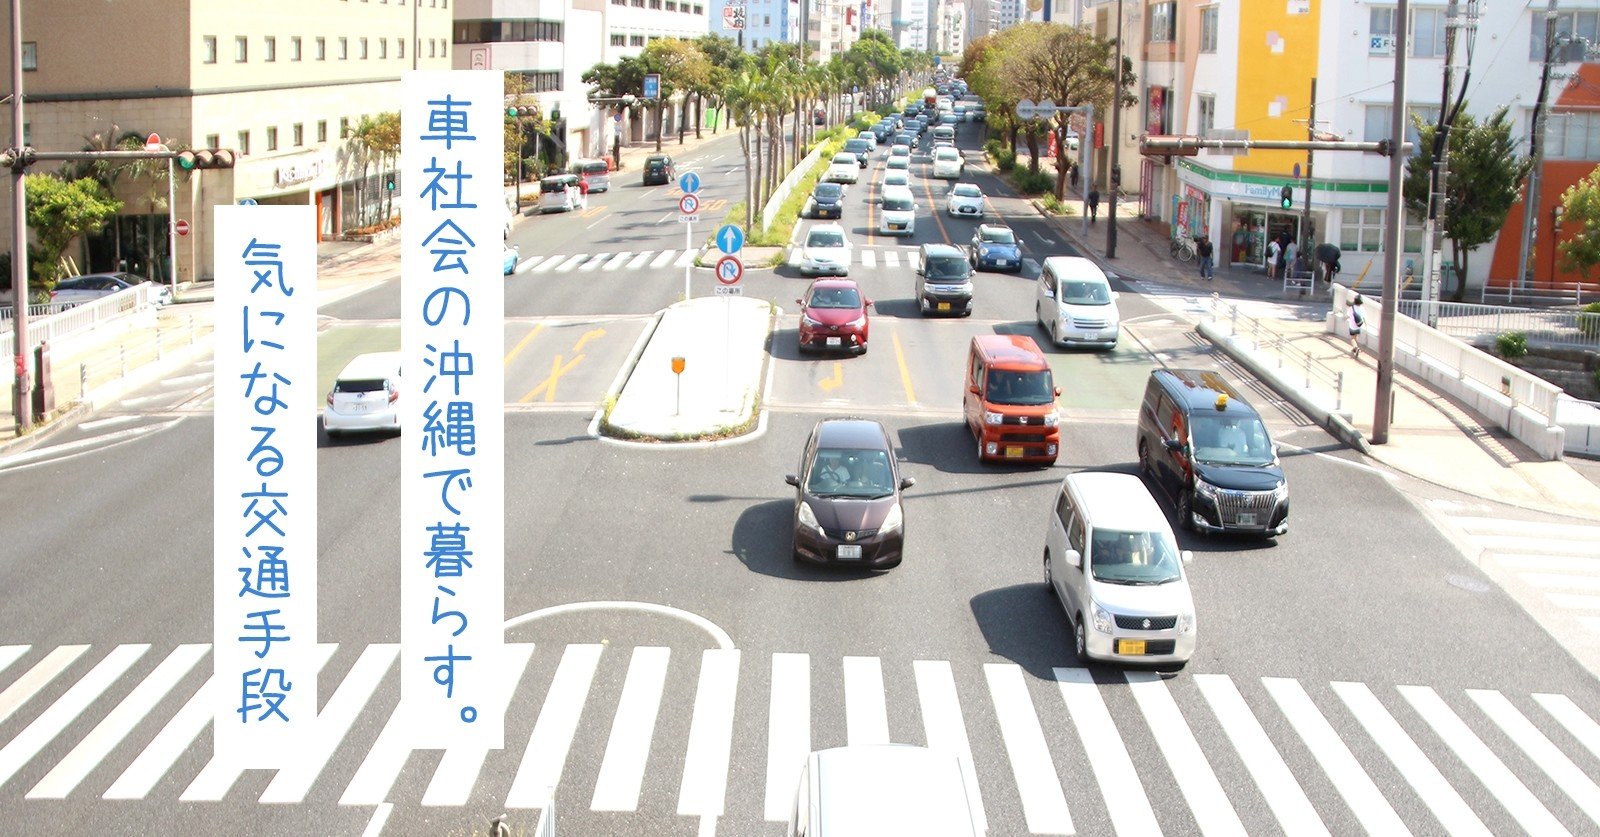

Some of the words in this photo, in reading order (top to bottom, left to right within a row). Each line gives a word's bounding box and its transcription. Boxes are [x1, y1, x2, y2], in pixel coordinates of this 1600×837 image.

[1245, 184, 1283, 198] FamilyM
[716, 287, 741, 295] この場所
